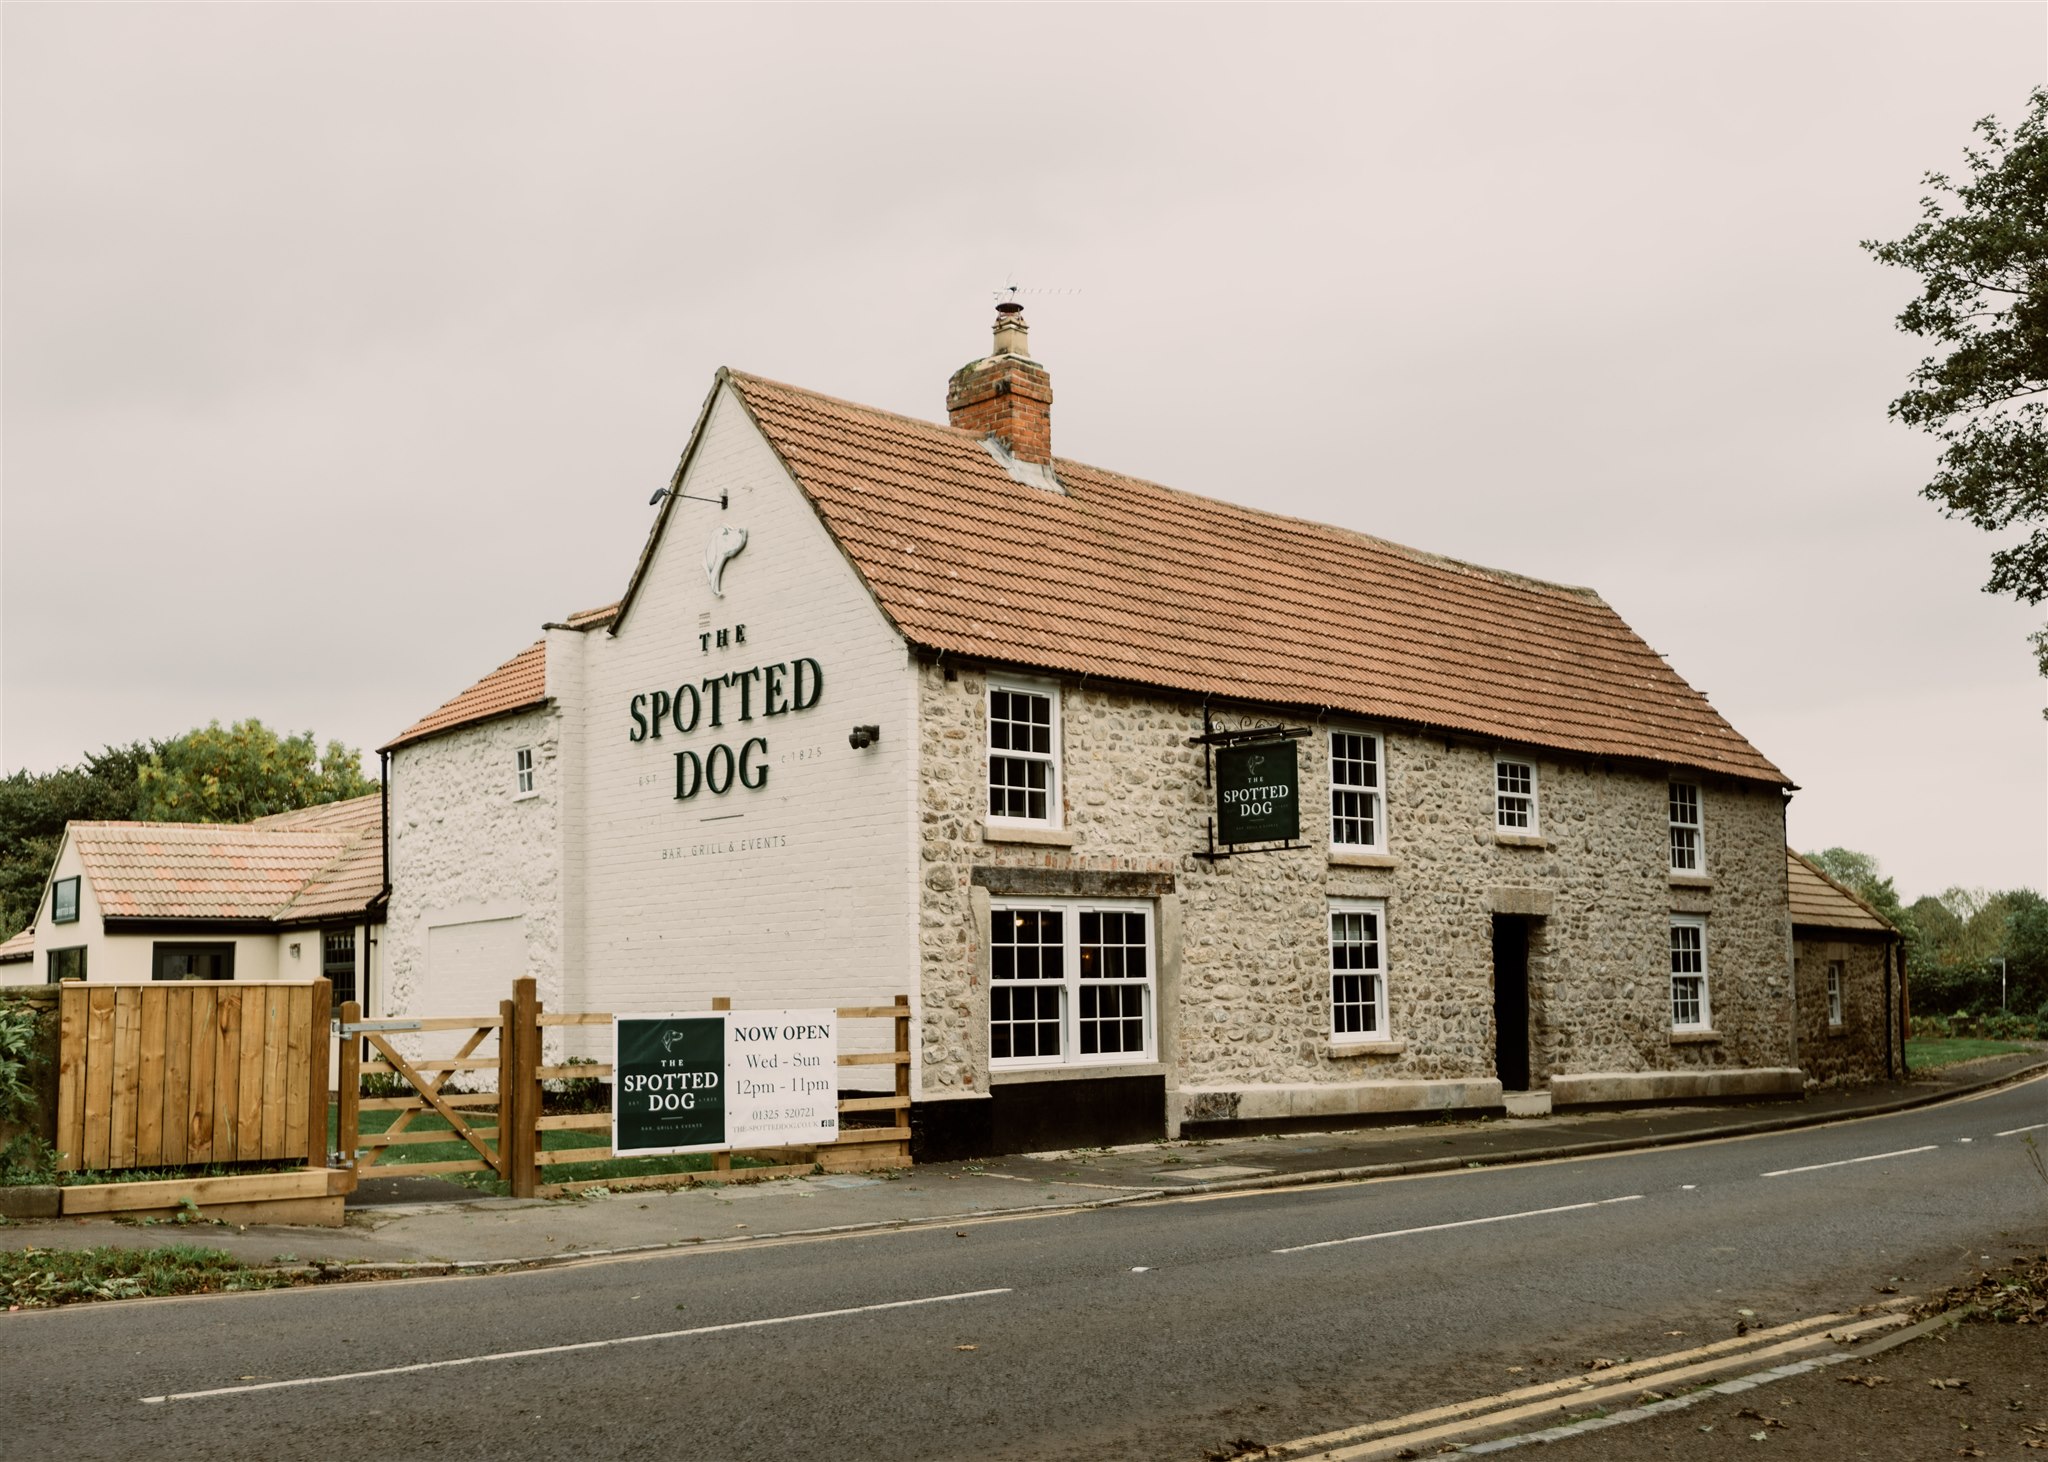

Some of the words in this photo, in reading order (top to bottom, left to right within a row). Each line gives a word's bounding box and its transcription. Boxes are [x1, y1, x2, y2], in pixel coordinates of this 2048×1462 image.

[699, 623, 747, 652] THE
[630, 657, 824, 742] SPOTTED
[673, 737, 769, 800] DOG
[1224, 785, 1288, 803] SPOTTED
[1241, 801, 1272, 816] DOG
[691, 843, 724, 857] GRILL
[728, 840, 735, 853] &
[741, 834, 787, 852] EVENTS
[734, 1026, 779, 1042] NOW
[783, 1024, 830, 1041] OPEN
[661, 1059, 683, 1067] THE
[746, 1053, 778, 1069] Wed
[793, 1052, 820, 1068] Sun
[624, 1071, 719, 1093] SPOTTED
[736, 1079, 775, 1099] 12pm
[792, 1077, 829, 1096] 11pm
[648, 1092, 695, 1112] DOG
[752, 1109, 779, 1121] 01325
[784, 1107, 815, 1119] 520721
